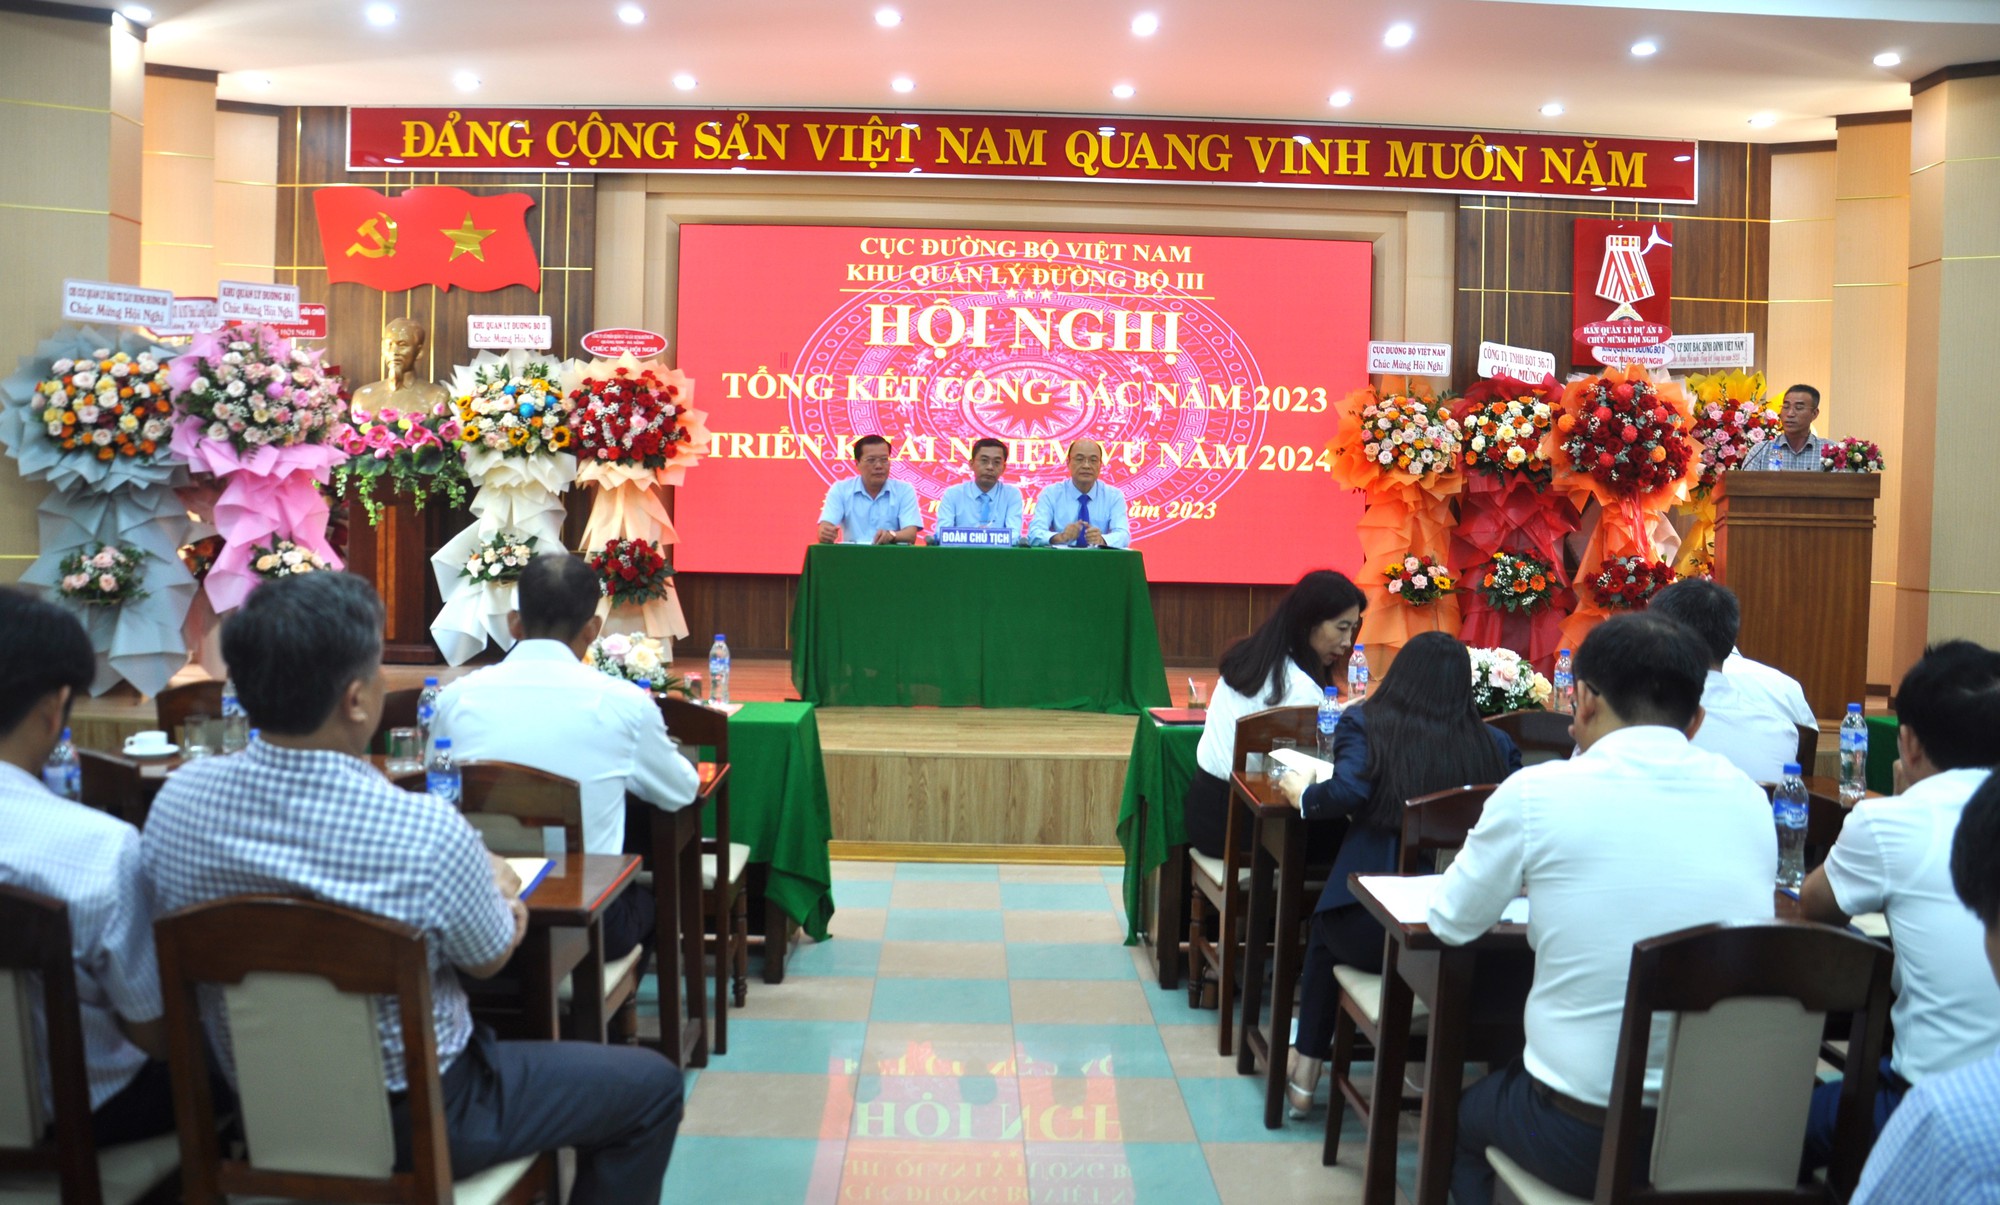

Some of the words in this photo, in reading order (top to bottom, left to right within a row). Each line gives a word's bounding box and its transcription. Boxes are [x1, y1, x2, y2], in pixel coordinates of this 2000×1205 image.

[402, 112, 532, 159] ĐẢNG
[545, 112, 676, 166] CỘNG
[694, 113, 787, 161] SẢN
[803, 115, 921, 169] VIỆT
[935, 126, 1047, 165] NAM
[1065, 129, 1233, 178] QUANG
[1245, 135, 1370, 177] VINH
[1385, 134, 1528, 183] MUÔN
[1540, 138, 1647, 188] NĂM
[860, 237, 915, 259] CỤC
[921, 235, 1016, 257] ĐƯỜNG
[1024, 239, 1060, 263] BỘ
[1066, 241, 1126, 264] VIỆT
[1133, 245, 1192, 263] NAM
[847, 263, 903, 282] KHU
[910, 262, 983, 286] QUẢN
[991, 263, 1026, 285] LÝ
[1032, 264, 1126, 288] ĐƯỜNG
[1134, 269, 1169, 293] BỘ
[1176, 272, 1205, 290] III
[864, 298, 991, 360] HỘI
[1011, 305, 1185, 364] NGHỊ
[1372, 358, 1390, 369] Chúc
[1392, 359, 1411, 371] Mừng
[1413, 360, 1425, 372] Hội
[1427, 361, 1443, 373] Nghị
[1432, 348, 1446, 357] NAM
[1483, 346, 1500, 360] CÔNG
[1501, 350, 1507, 362] TY
[722, 366, 835, 401] TỔNG
[847, 367, 927, 402] KẾT
[936, 370, 1052, 405] CÔNG
[1062, 373, 1142, 407] TÁC
[1152, 377, 1244, 410] NĂM
[1254, 385, 1328, 413] 2023
[707, 425, 825, 460] TRIỂN
[834, 434, 938, 463] KAI
[949, 436, 1070, 472] NIỆM
[1100, 441, 1149, 474] VỤ
[1157, 437, 1249, 471] NĂM
[1258, 445, 1332, 472] 2024
[1128, 500, 1160, 518] ăm
[1166, 501, 1217, 519] 2023
[942, 531, 967, 543] ĐOÀN
[969, 530, 988, 543] CHỦ
[989, 532, 1010, 545] TỊCH
